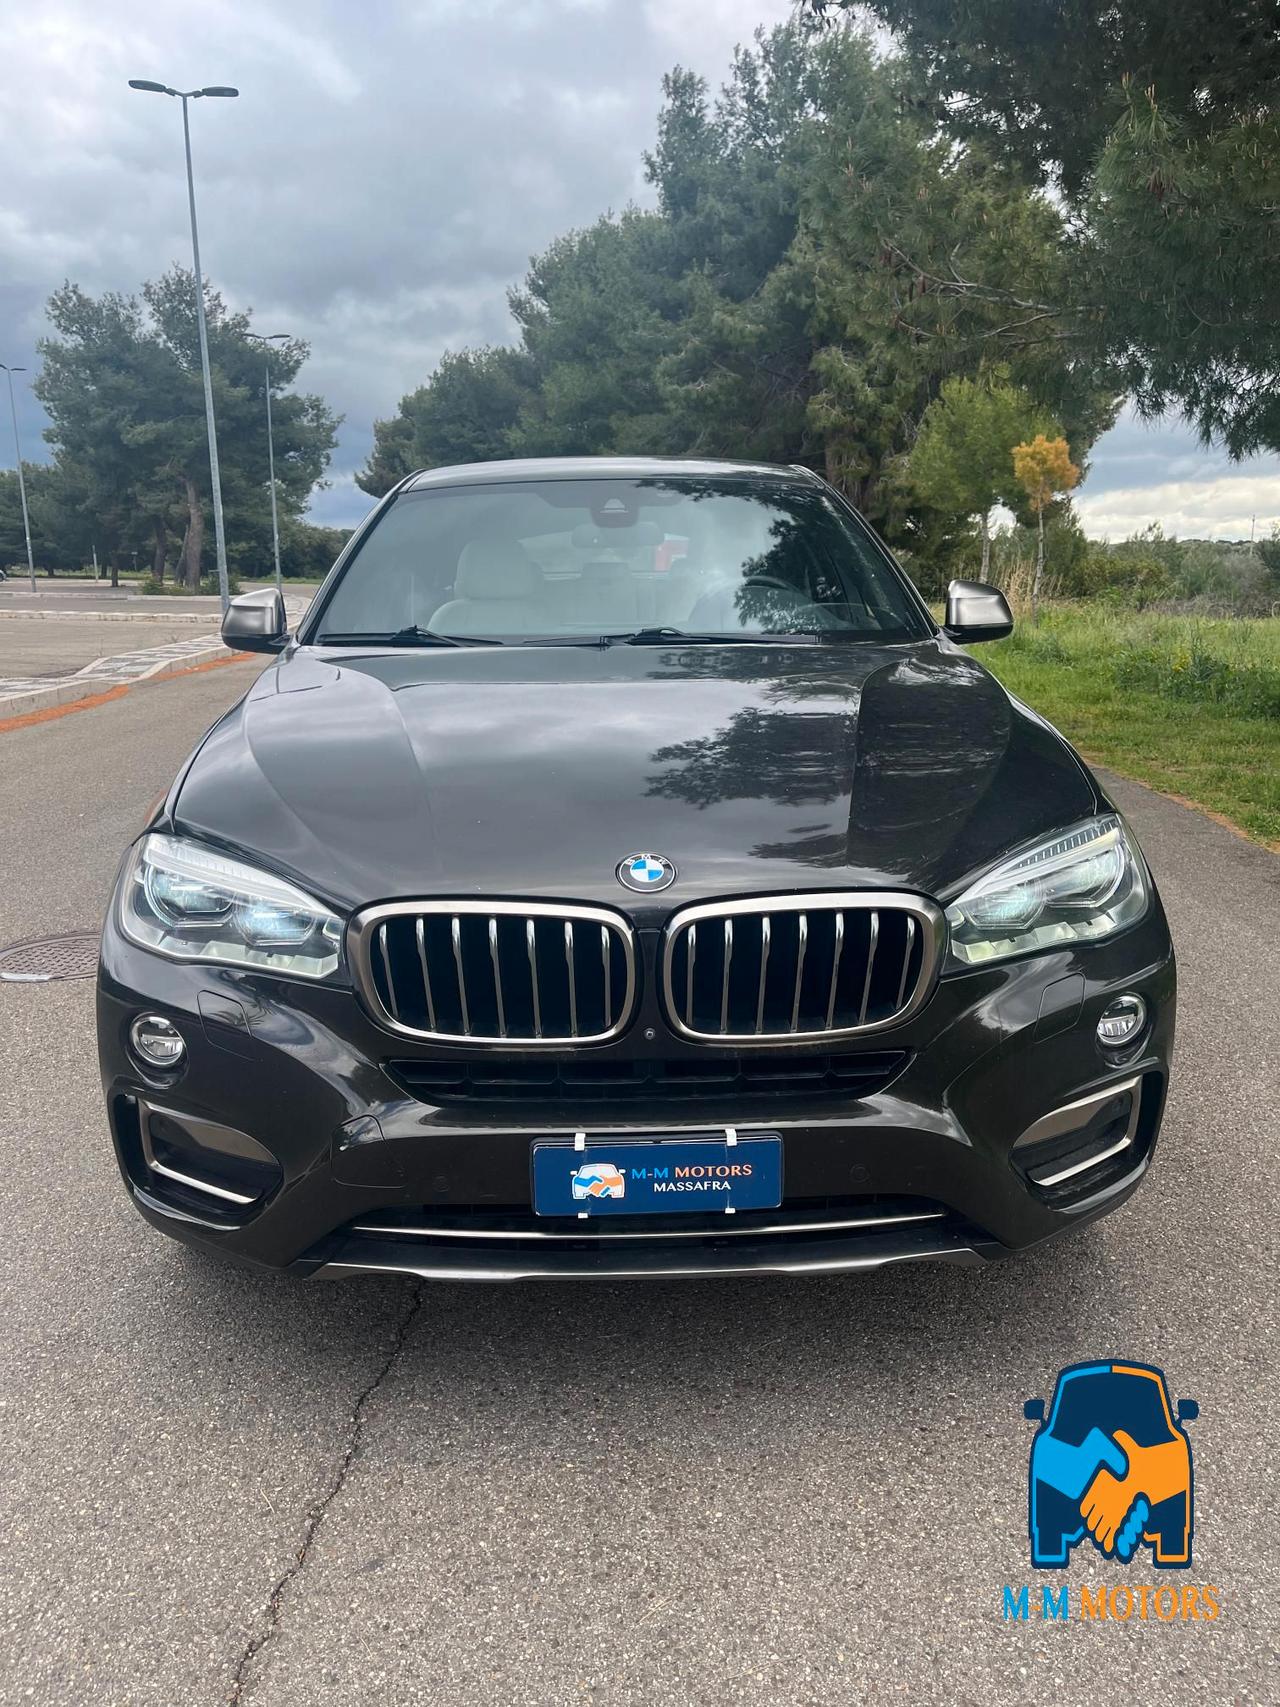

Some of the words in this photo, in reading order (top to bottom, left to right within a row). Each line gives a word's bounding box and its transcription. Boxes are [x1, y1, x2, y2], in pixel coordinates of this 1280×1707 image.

[631, 1167, 669, 1180] M-M
[675, 1164, 752, 1178] MOTORS
[653, 1180, 731, 1192] MASSAFRA
